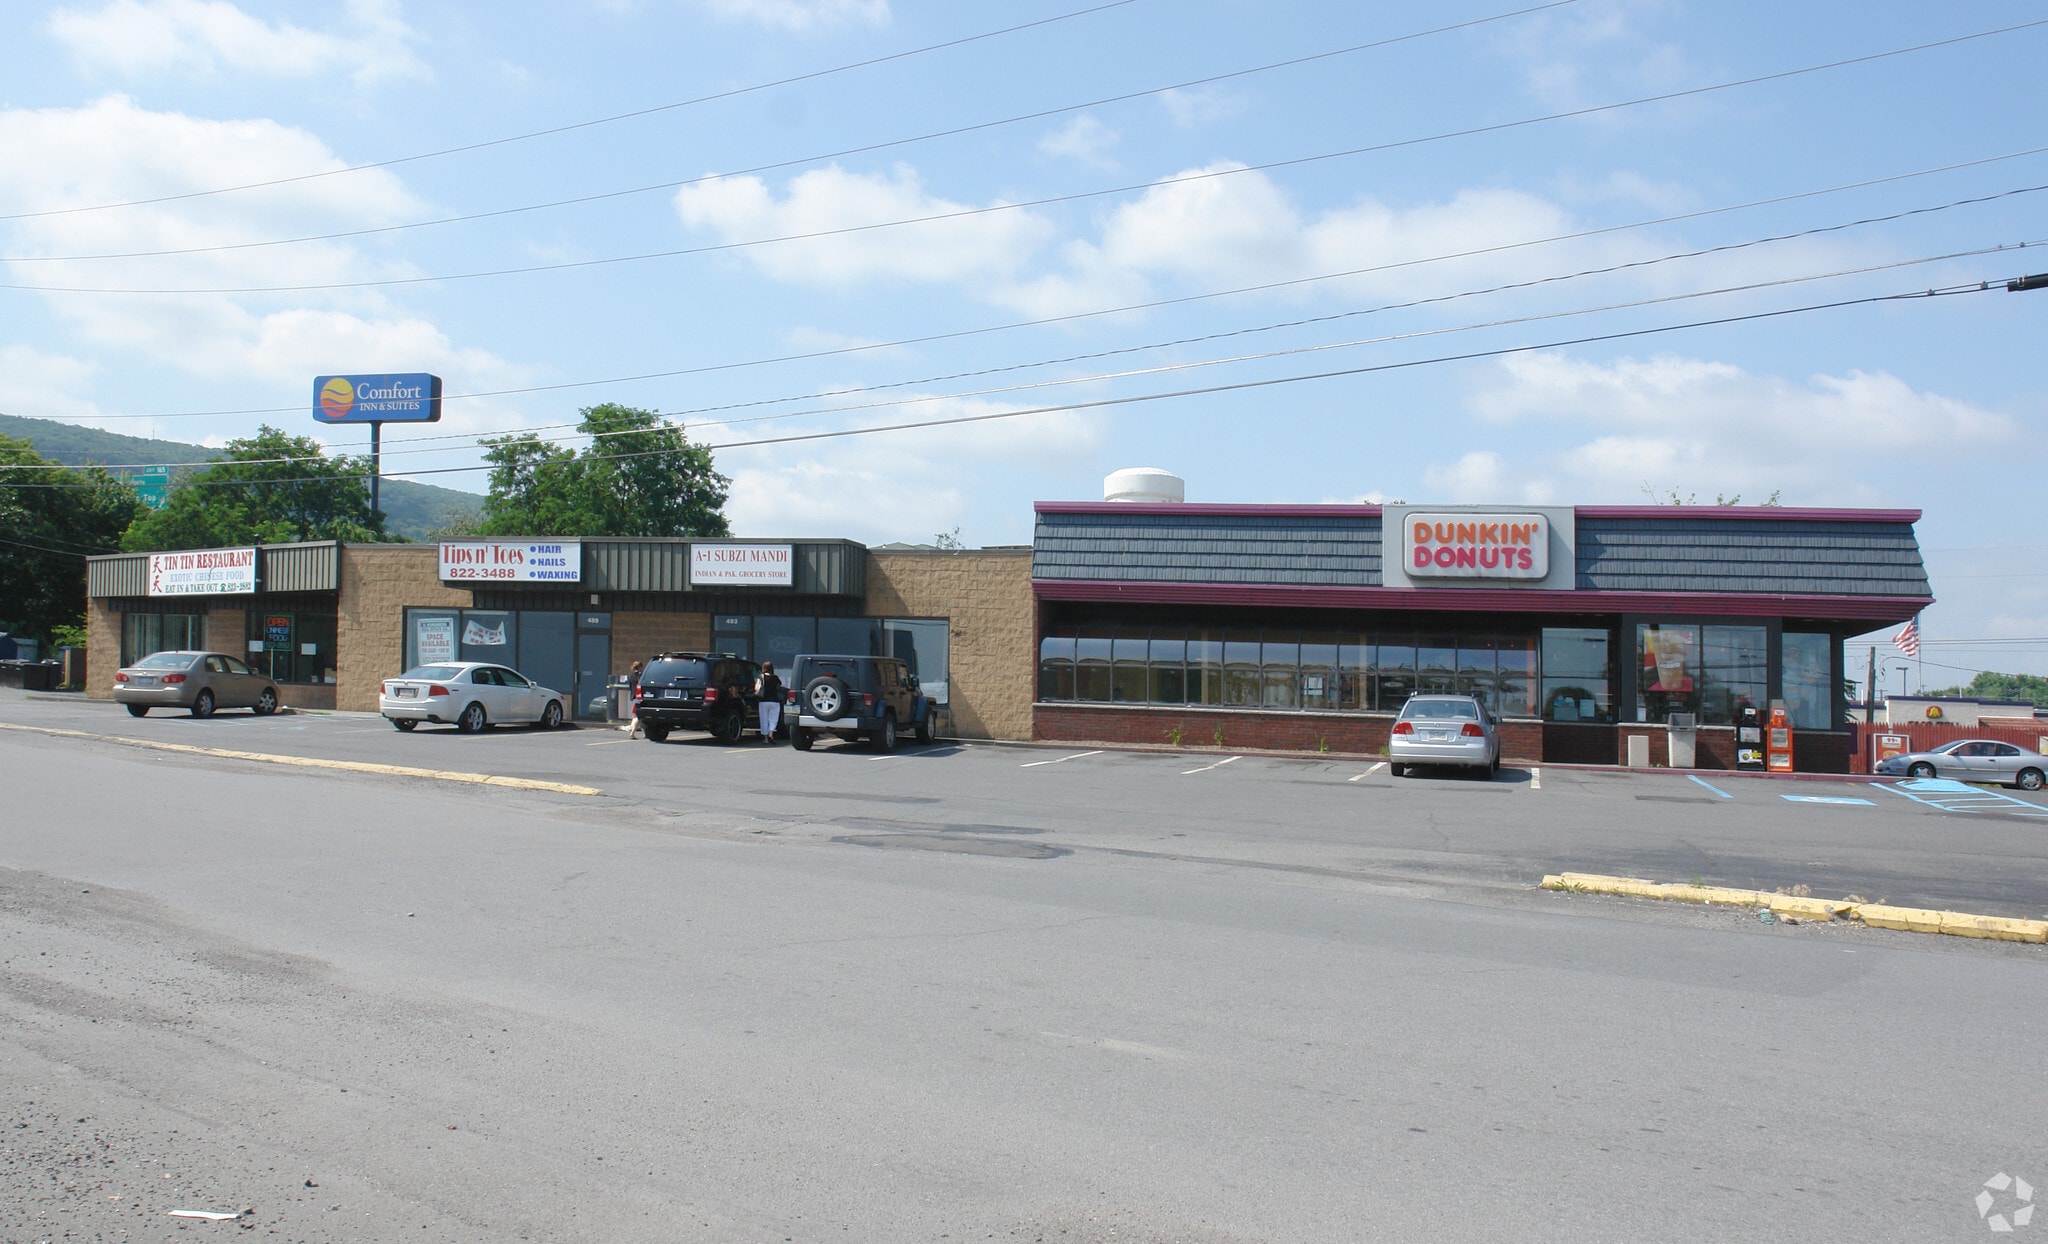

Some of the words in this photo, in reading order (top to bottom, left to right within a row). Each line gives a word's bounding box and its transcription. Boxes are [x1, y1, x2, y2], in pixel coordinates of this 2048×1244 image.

[357, 381, 421, 400] Comfort
[360, 402, 378, 411] INN
[379, 402, 386, 411] &
[387, 401, 420, 411] SUITES
[1413, 521, 1539, 545] DUNKIN'
[442, 544, 473, 565] Tips
[492, 544, 524, 565] Toes
[537, 545, 562, 554] HAIR
[714, 549, 746, 562] SUBZI
[750, 550, 787, 562] MANDI
[164, 555, 179, 571] TIN
[180, 554, 195, 570] TIN
[196, 550, 254, 569] RESTAURANT
[537, 557, 566, 566] NAILS
[1413, 545, 1533, 570] DONUTS
[170, 572, 192, 583] EXOTIC
[194, 571, 224, 582] CHINESE
[225, 570, 245, 580] FOOD
[450, 567, 516, 579] 822-3488
[537, 570, 578, 580] WAXING
[165, 584, 175, 593] EAT
[176, 584, 184, 593] IN
[189, 583, 205, 592] TAKE
[206, 582, 219, 592] OUT
[267, 616, 289, 627] OPEN
